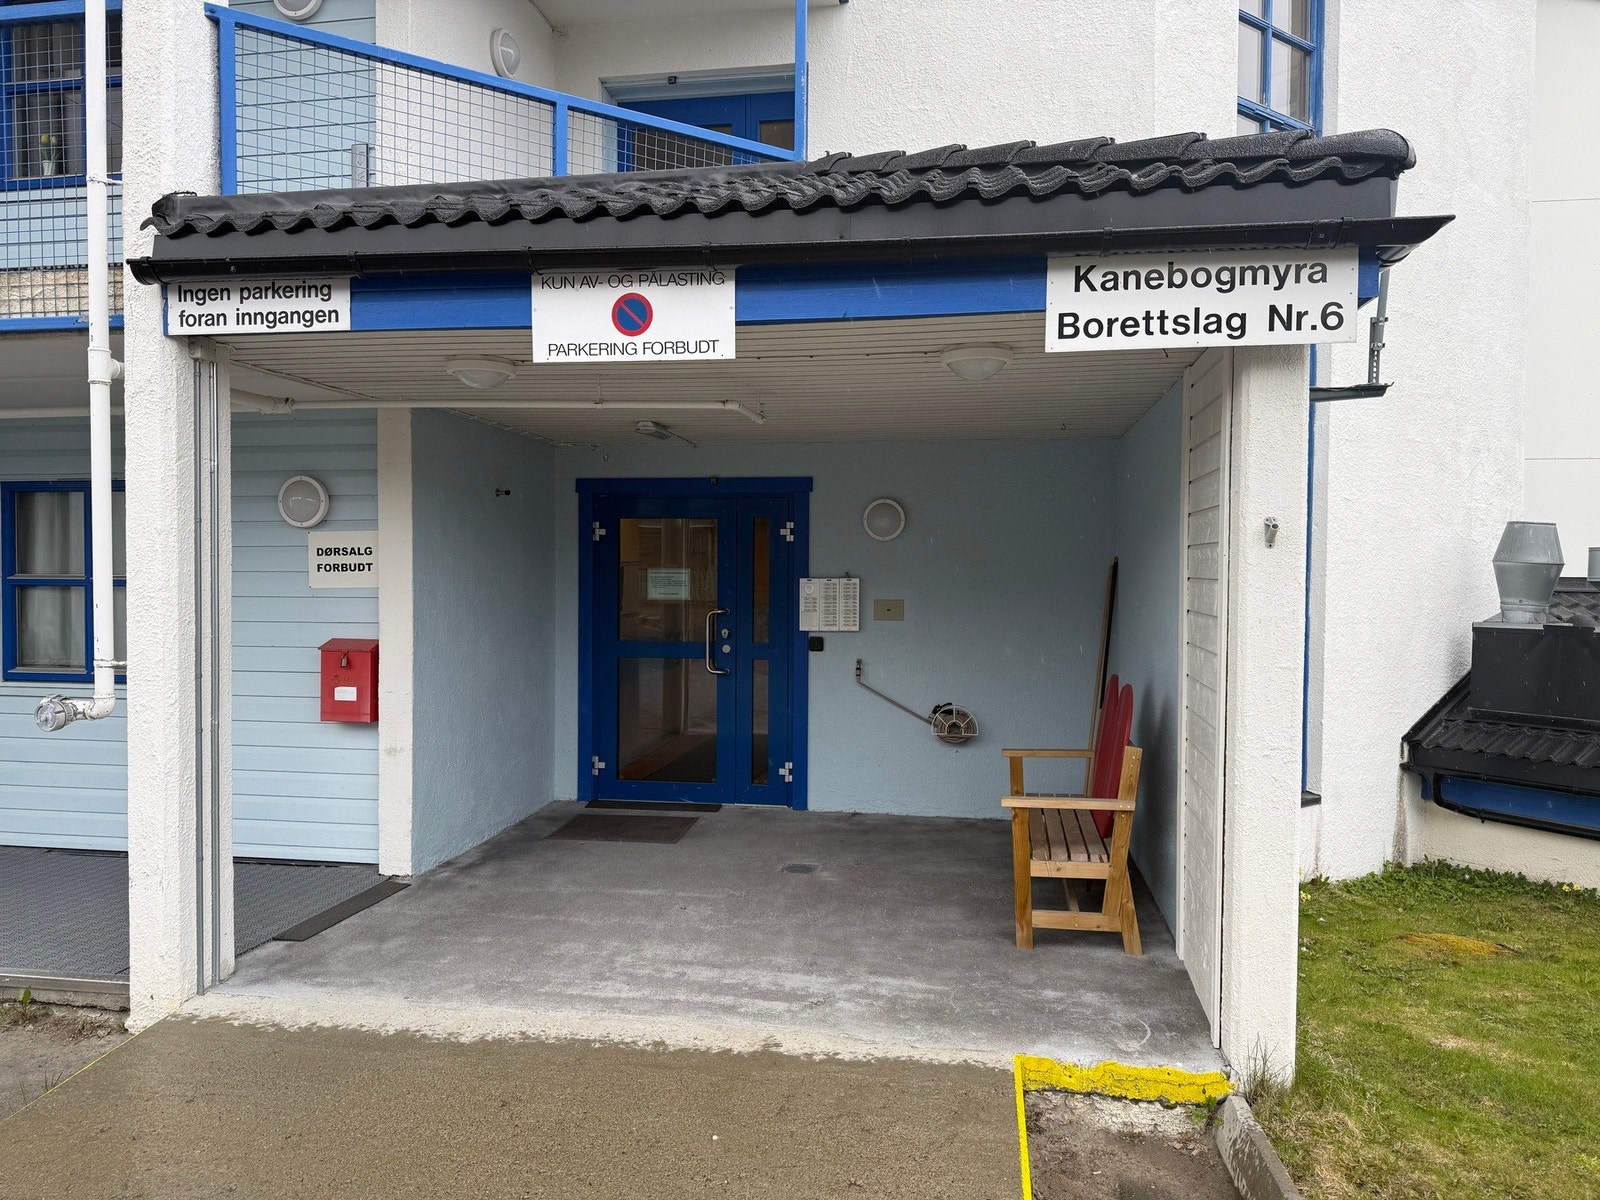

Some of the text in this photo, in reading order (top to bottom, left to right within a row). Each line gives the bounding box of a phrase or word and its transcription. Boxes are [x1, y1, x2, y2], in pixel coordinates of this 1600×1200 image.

[541, 271, 726, 290] KUN AV- OG PÅLASTING
[1074, 261, 1328, 294] Kanebogmyra
[178, 280, 332, 306] Ingen parkering
[178, 308, 339, 329] foran inngangen
[1057, 302, 1344, 340] Borettslag Nr.6
[548, 339, 720, 357] PARKERING FORBUDT
[316, 546, 373, 557] DØRSALG
[316, 562, 373, 573] FORBUDT
